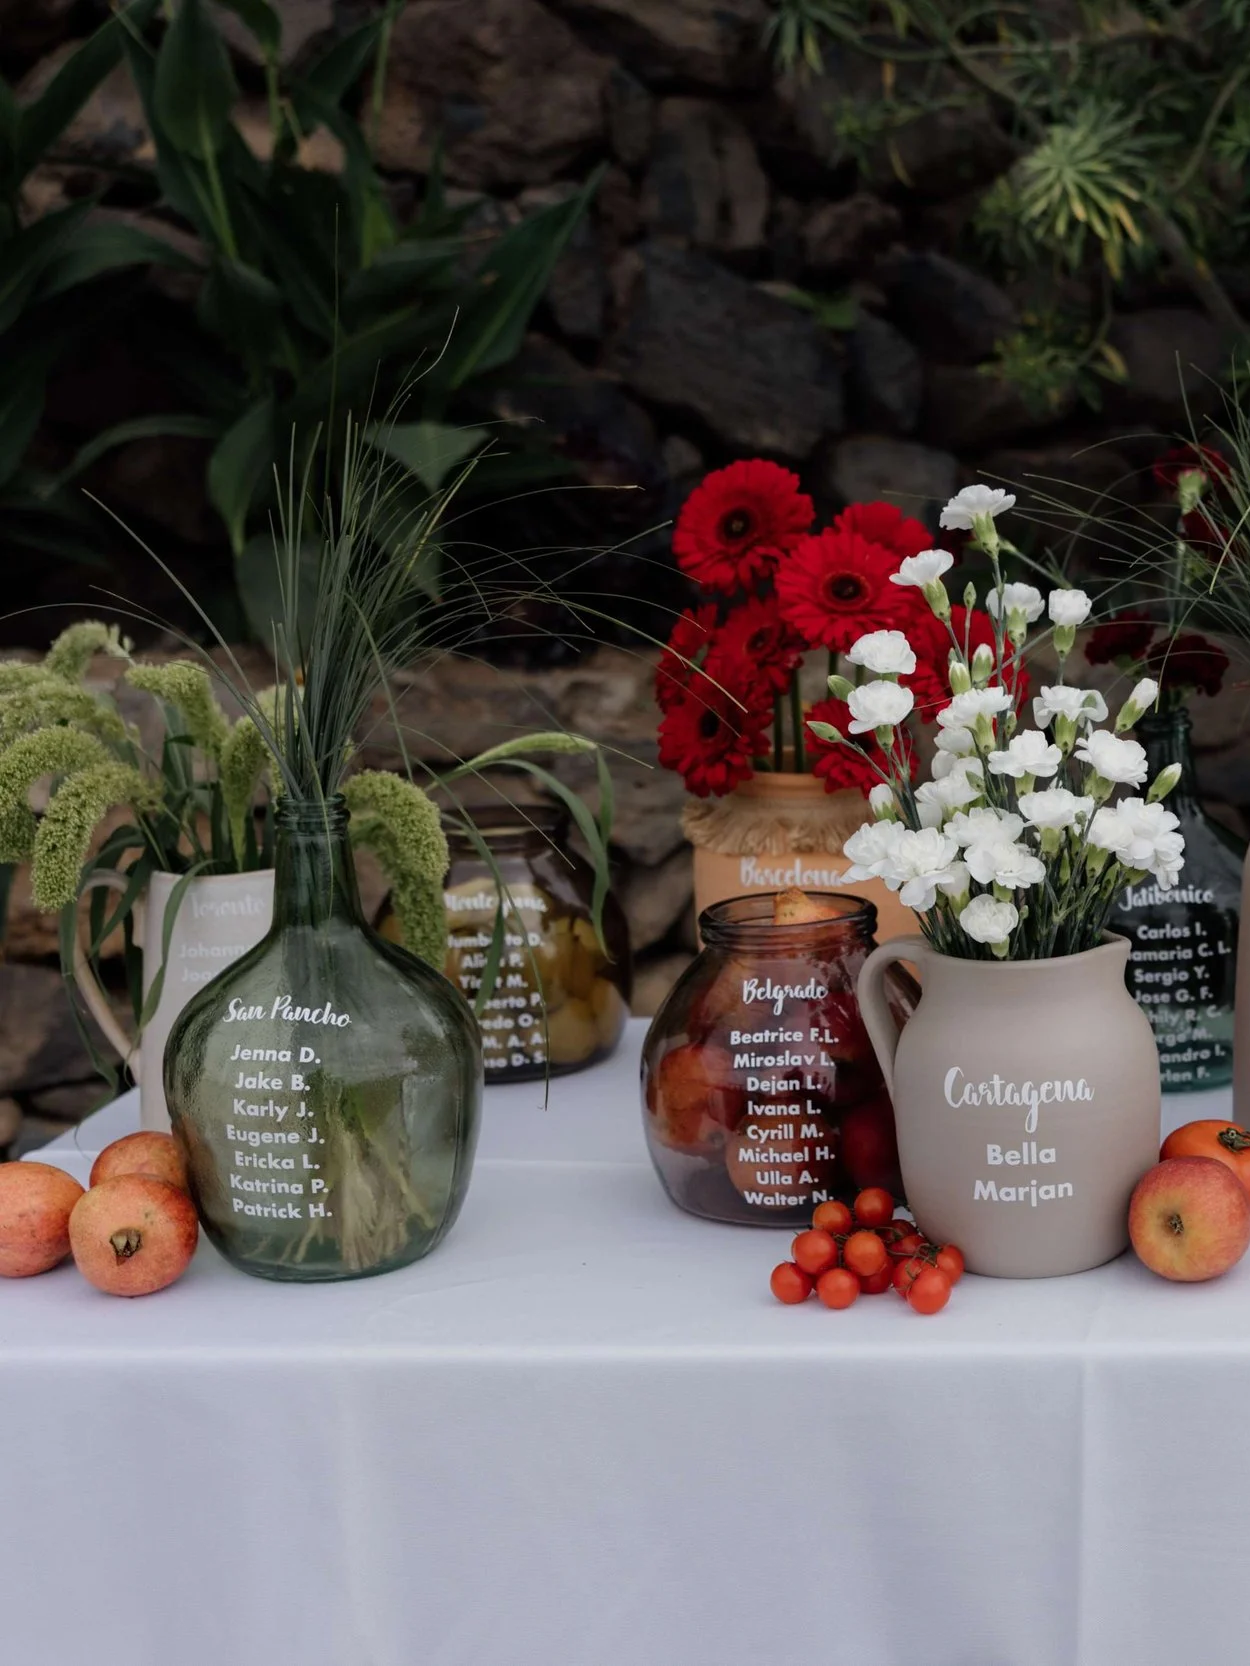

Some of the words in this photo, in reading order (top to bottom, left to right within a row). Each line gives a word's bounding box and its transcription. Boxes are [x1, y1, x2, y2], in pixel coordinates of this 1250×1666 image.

[739, 856, 842, 887] Barcelona
[1118, 883, 1214, 911] Jatibonico
[1137, 923, 1191, 940] Carlos
[1198, 943, 1214, 957] C.
[1218, 941, 1232, 954] L.
[506, 973, 528, 988] M.
[1134, 967, 1189, 986] Sergio
[1194, 966, 1210, 980] Y.
[742, 977, 828, 1016] Belgrade
[1175, 988, 1195, 1002] G.
[1200, 986, 1214, 1000] F.
[223, 998, 266, 1022] San
[271, 995, 352, 1028] Pancho
[518, 1013, 540, 1028] O.
[507, 1033, 526, 1049] A.
[730, 1027, 803, 1045] Beatrice
[810, 1028, 839, 1043] F.L.
[230, 1045, 291, 1062] Jenna
[299, 1047, 321, 1064] D.
[511, 1053, 531, 1068] D.
[734, 1050, 815, 1068] Miroslav
[820, 1052, 835, 1067] L.
[235, 1072, 283, 1090] Jake
[291, 1074, 311, 1091] B.
[747, 1076, 800, 1095] Dejan
[806, 1076, 822, 1089] L.
[747, 1101, 800, 1115] Ivana
[807, 1100, 821, 1114] L.
[944, 1066, 1095, 1133] Cartagena
[233, 1099, 288, 1122] Karly
[296, 1102, 314, 1117] J.
[226, 1124, 300, 1147] Eugene
[307, 1128, 325, 1144] J.
[747, 1124, 793, 1143] Cyrill
[800, 1124, 824, 1138] M.
[235, 1151, 294, 1169] Ericka
[302, 1154, 320, 1170] L.
[739, 1147, 809, 1163] Michael
[816, 1147, 836, 1160] H.
[987, 1142, 1056, 1166] Bella
[230, 1173, 303, 1195] Katrina
[311, 1179, 329, 1193] P.
[756, 1172, 792, 1185] Ulla
[799, 1170, 819, 1184] A.
[744, 1191, 807, 1206] Walter
[812, 1190, 834, 1203] N.
[974, 1180, 1074, 1207] Marjan
[232, 1198, 302, 1219] Patrick
[308, 1203, 333, 1218] H.
